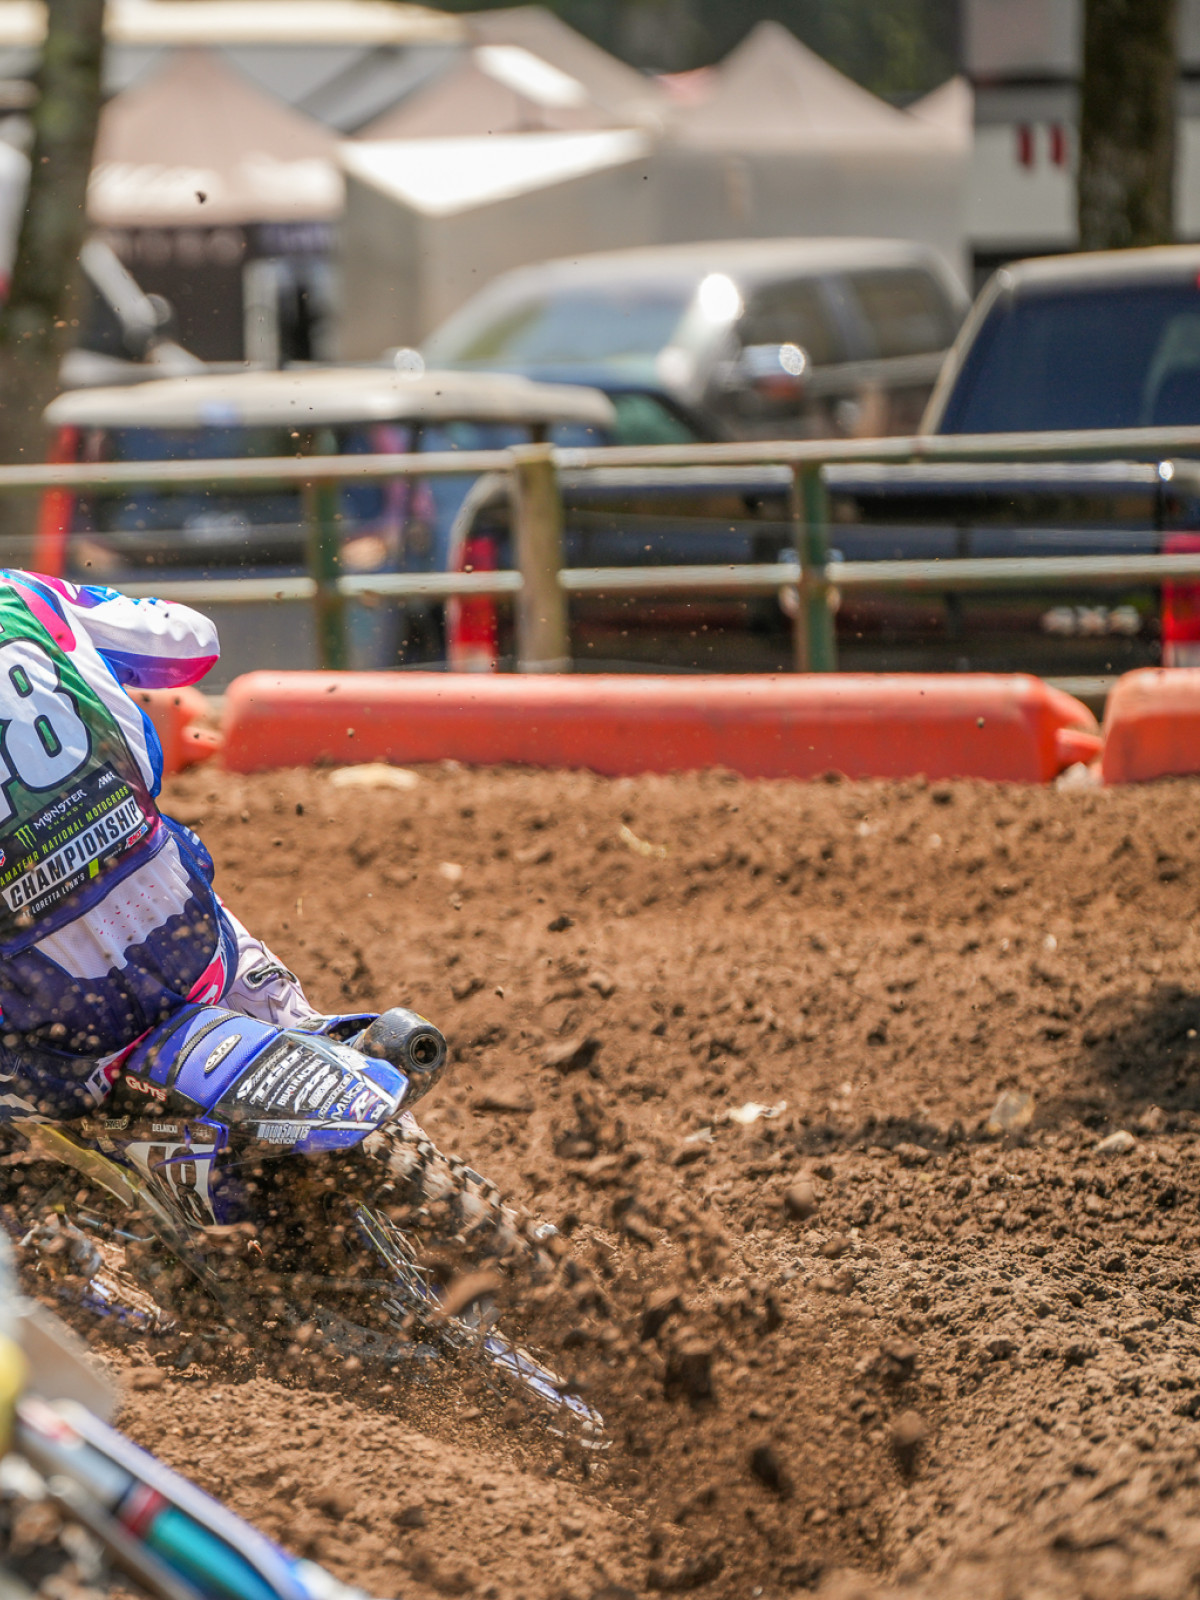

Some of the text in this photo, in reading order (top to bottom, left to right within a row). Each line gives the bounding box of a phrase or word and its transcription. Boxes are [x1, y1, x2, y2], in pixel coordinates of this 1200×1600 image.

[33, 789, 87, 830] MONSTER
[0, 850, 39, 886] AMATEUR
[42, 818, 84, 855] NATIONAL
[85, 785, 129, 823] MOTOCROSS
[10, 800, 139, 908] CHAMPIONSHIP
[32, 889, 61, 914] LORETTA
[125, 1076, 167, 1102] GUTS
[268, 1137, 296, 1145] NATION
